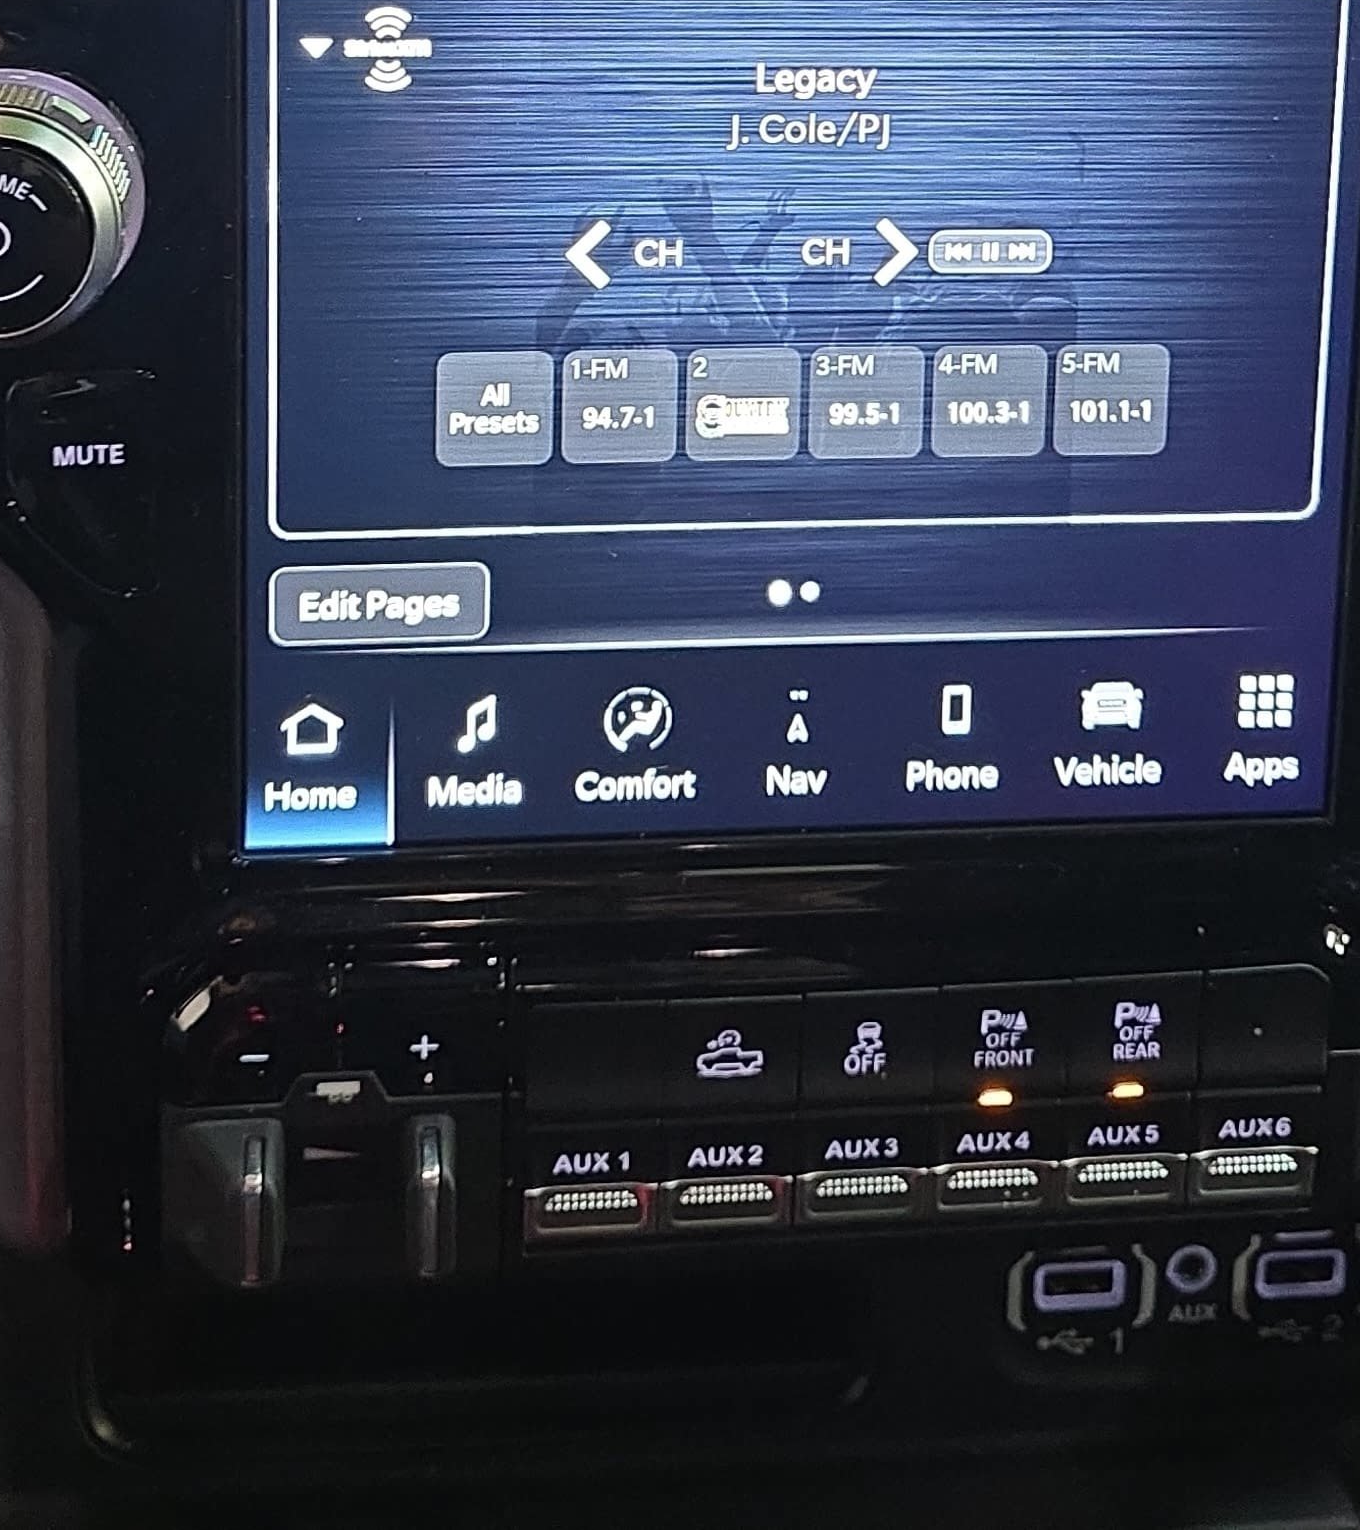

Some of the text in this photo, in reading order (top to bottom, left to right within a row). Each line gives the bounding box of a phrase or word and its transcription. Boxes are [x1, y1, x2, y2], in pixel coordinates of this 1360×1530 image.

[755, 61, 879, 100] Legacy
[725, 112, 892, 151] J. Cole/PJ
[633, 240, 684, 269] CH
[801, 238, 851, 266] CH
[570, 358, 629, 380] 1-FM
[692, 356, 708, 379] 2
[816, 355, 875, 376] 3-FM
[939, 354, 998, 375] 4-FM
[1062, 352, 1120, 374] 5-FM
[479, 382, 511, 408] All
[581, 405, 656, 431] 94.7-1
[828, 401, 901, 426] 99.5-1
[947, 400, 1031, 424] 100.3-1
[1069, 398, 1153, 423] 101.1-1
[448, 410, 540, 436] Presets
[52, 443, 126, 467] MUTE
[298, 590, 460, 626] Edit Pages
[765, 765, 828, 797] Nav
[906, 759, 1000, 792] Phone
[1053, 753, 1163, 787] Vehicle
[1223, 751, 1300, 788] Apps
[264, 780, 358, 813] Home
[426, 773, 523, 808] Media
[573, 767, 697, 803] Comfort
[985, 1033, 1022, 1049] OFF
[1119, 1025, 1155, 1042] OFF
[974, 1048, 1035, 1067] FRONT
[1113, 1041, 1161, 1060] REAR
[844, 1052, 887, 1074] OFF
[1087, 1125, 1160, 1147] AUX 5
[1218, 1118, 1292, 1139] AUX 6
[824, 1138, 900, 1160] AUX 3
[956, 1132, 1030, 1154] AUX 4
[553, 1152, 630, 1174] AUX 1
[687, 1145, 764, 1168] AUX 2
[1167, 1303, 1218, 1322] AUX
